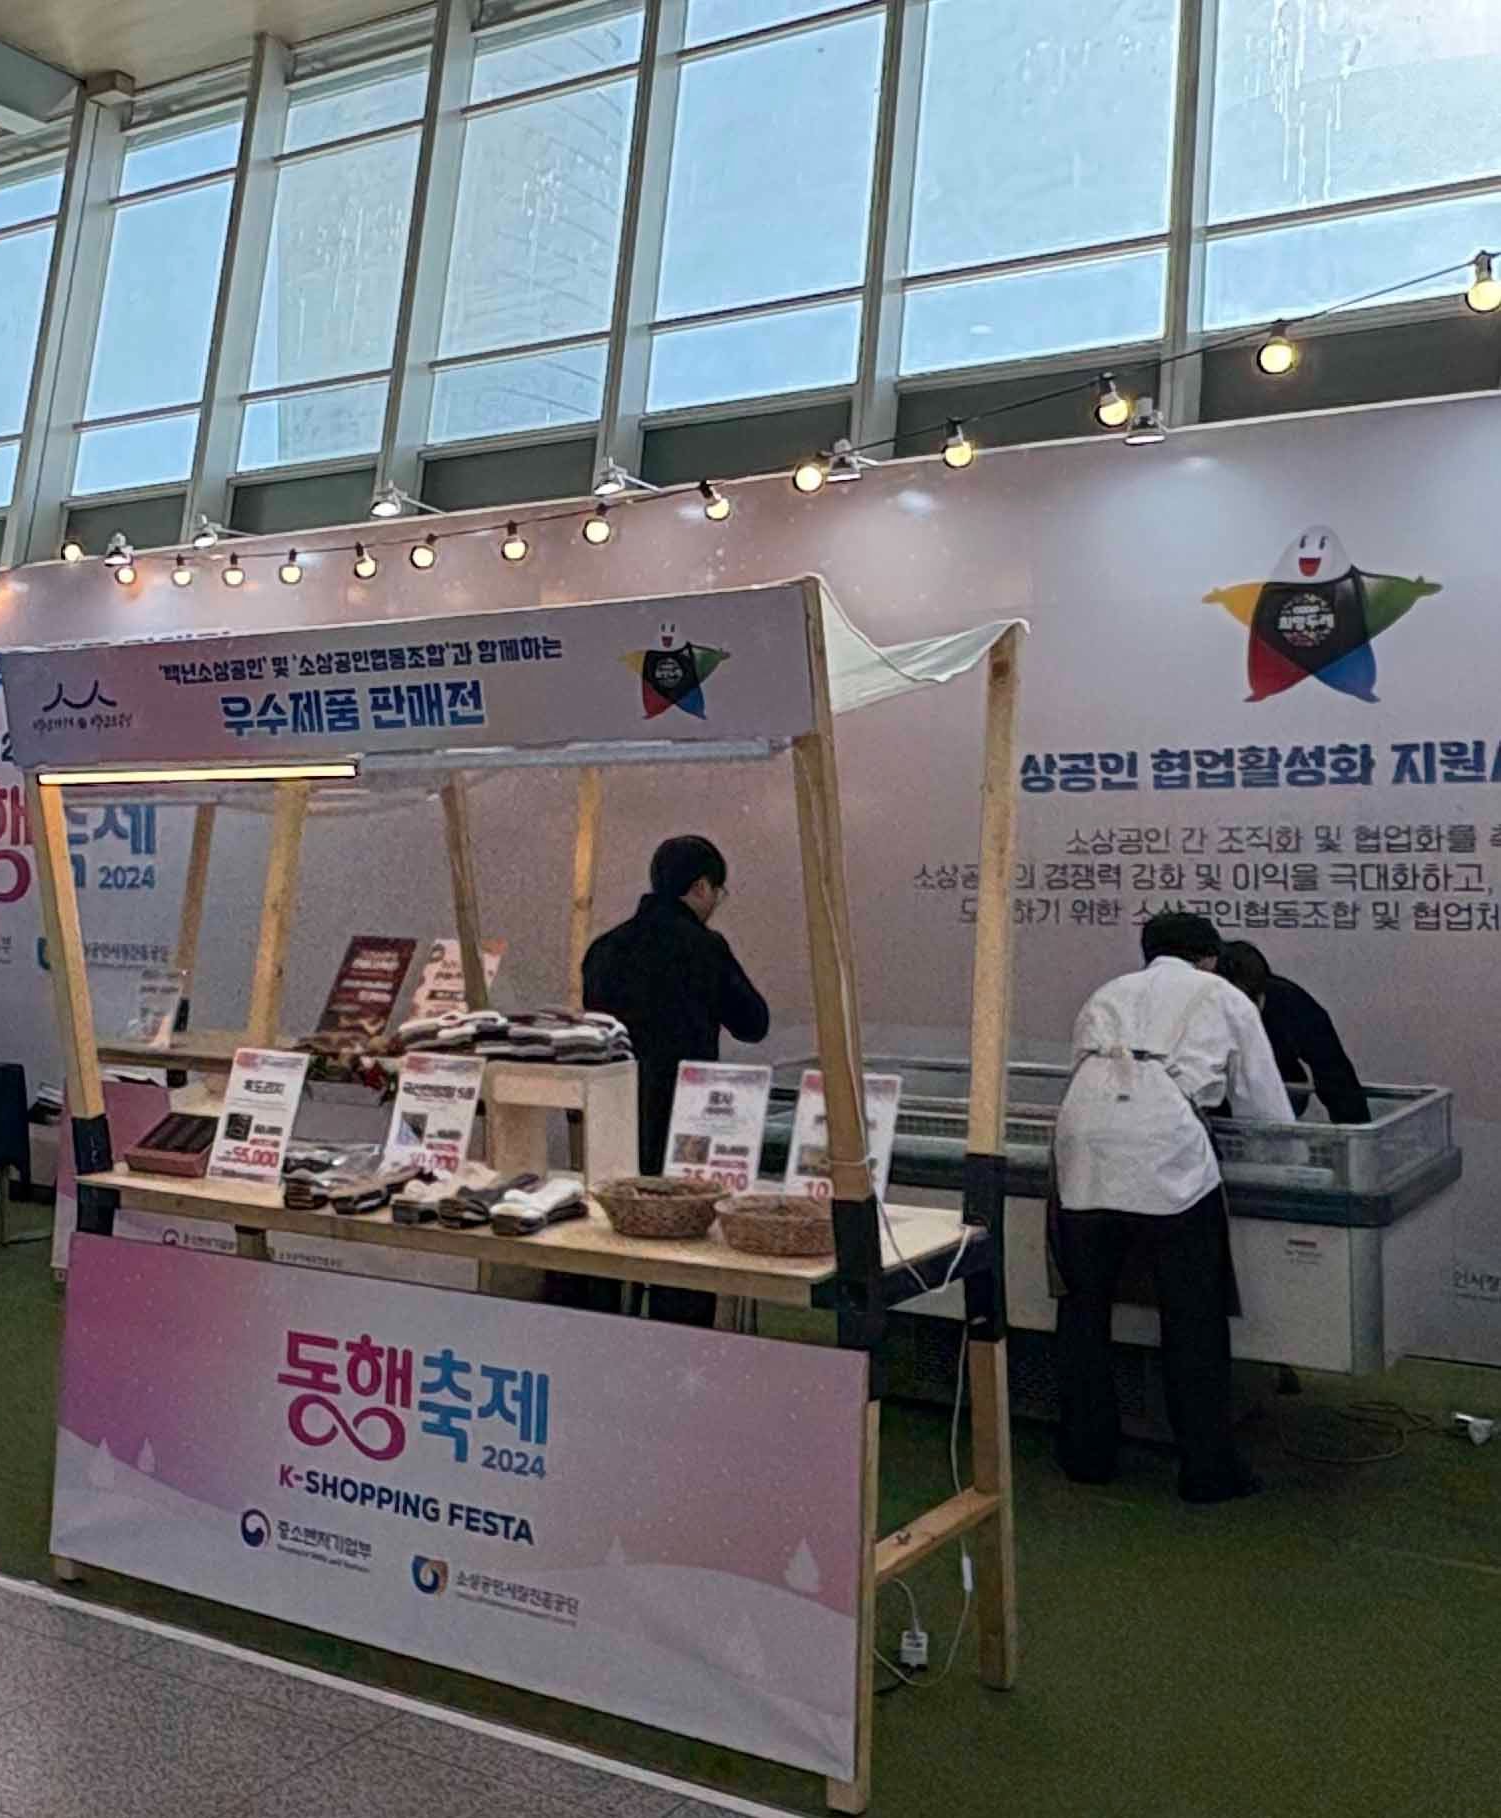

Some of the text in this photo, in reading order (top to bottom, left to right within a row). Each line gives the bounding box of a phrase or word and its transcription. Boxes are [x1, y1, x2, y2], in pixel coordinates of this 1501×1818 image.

[271, 656, 289, 678] 및
[476, 636, 563, 665] 함께하는
[221, 680, 485, 736] 우수제품 판매전
[1150, 744, 1376, 790] 협업활성화
[1391, 739, 1501, 785] 지원
[1066, 827, 1171, 855] 소상공인
[1182, 826, 1208, 855] 간
[1217, 824, 1302, 854] 조직화
[1314, 824, 1343, 853] 및
[1353, 823, 1477, 854] 협업화를
[99, 866, 156, 889] 2024
[1045, 862, 1122, 891] 경쟁력
[1132, 863, 1185, 891] 강화
[1196, 862, 1223, 891] 및
[1233, 861, 1319, 892] 이익을
[1329, 862, 1493, 895] 극대화하고,
[1071, 899, 1122, 926] 위한
[1371, 901, 1400, 930] 및
[277, 1330, 550, 1463] 동행축제
[481, 1445, 547, 1479] 2024
[278, 1463, 535, 1546] K-SHOPPING FESTA
[277, 1519, 373, 1560] 중소벤처기업부
